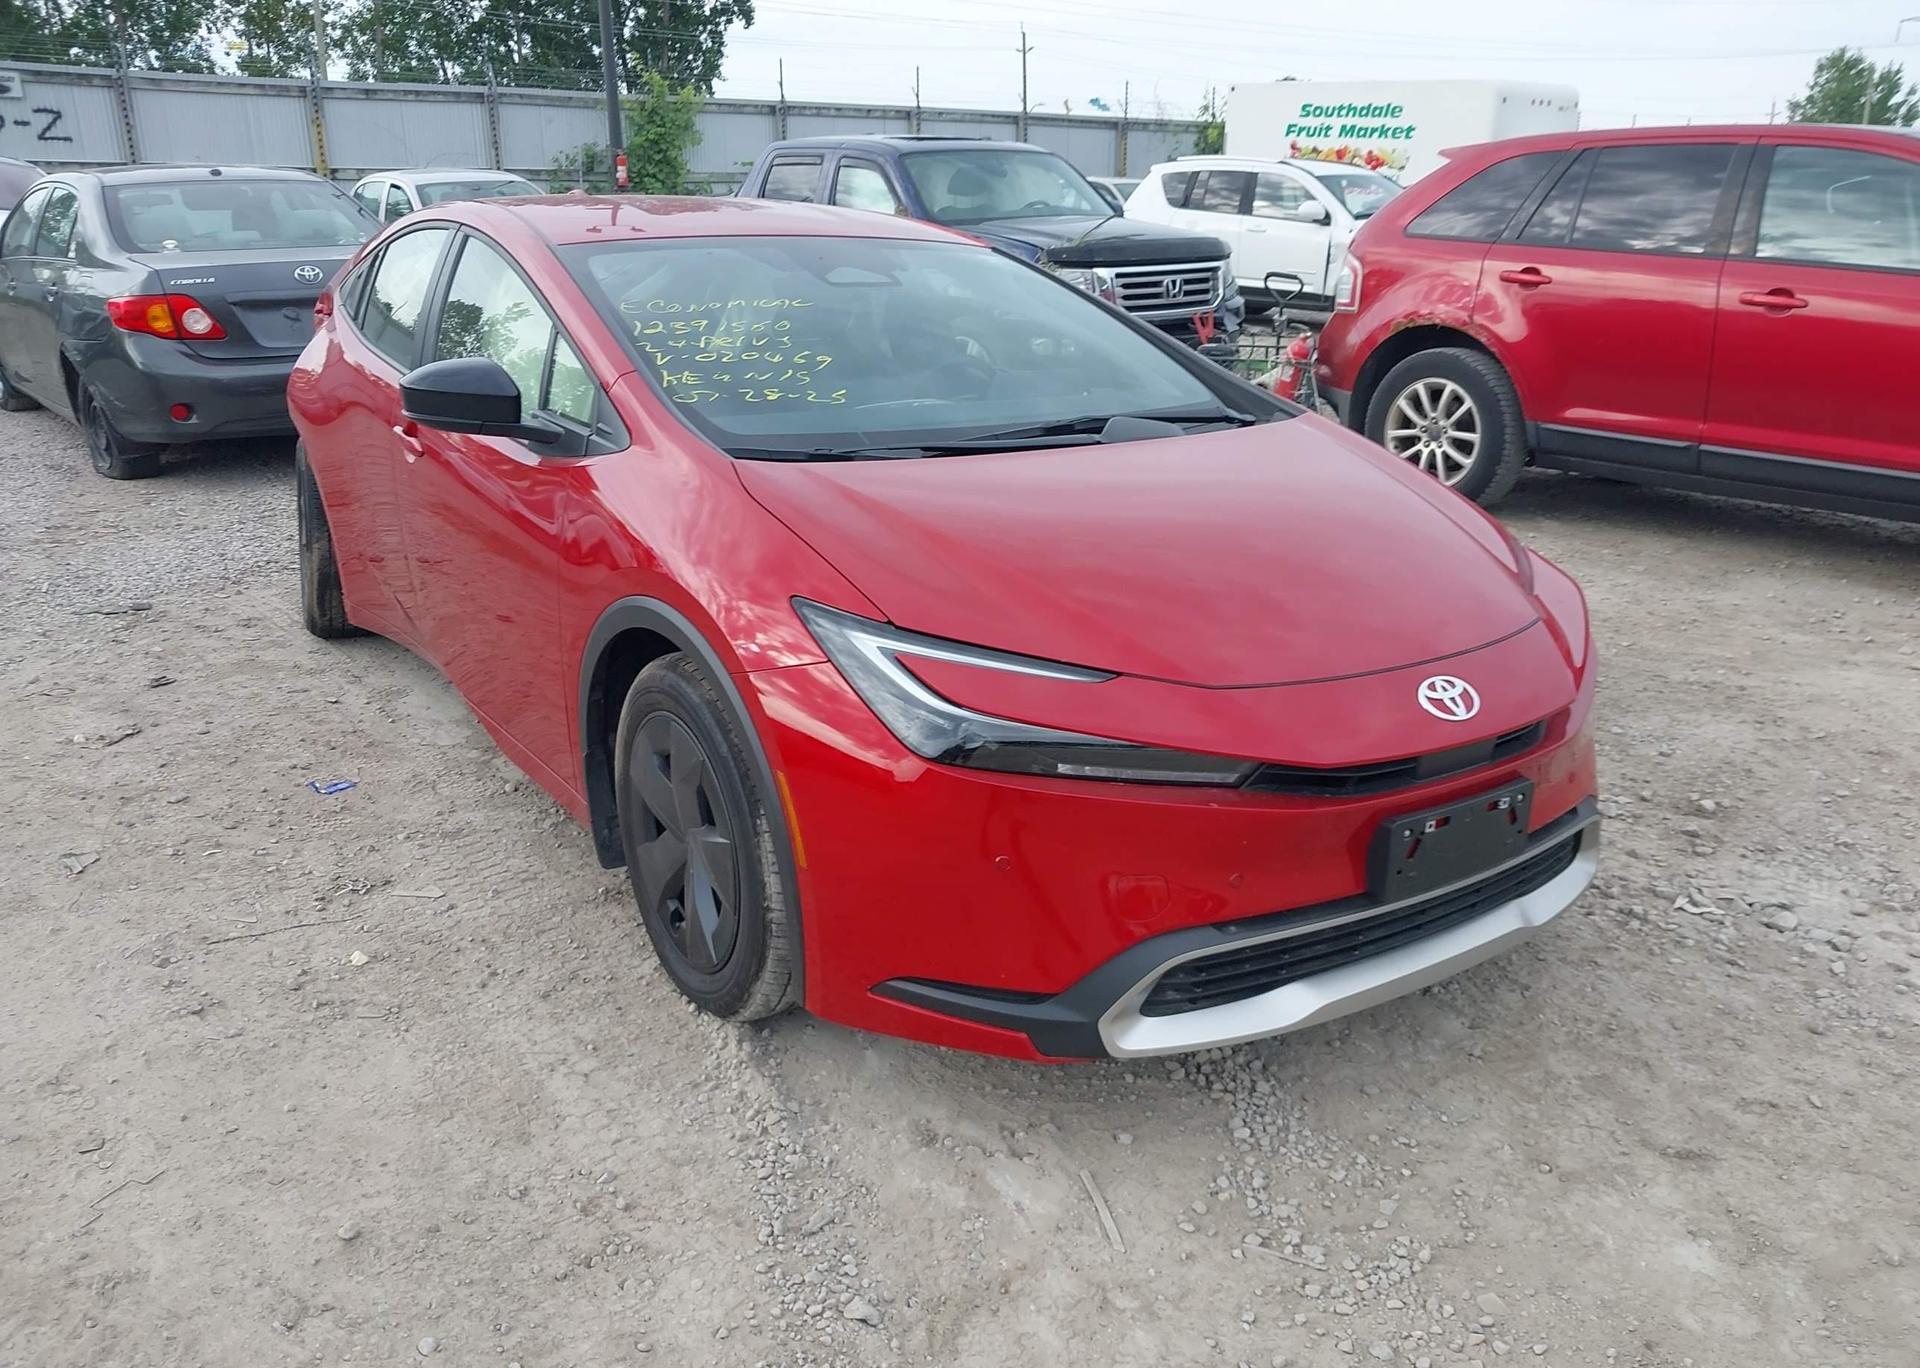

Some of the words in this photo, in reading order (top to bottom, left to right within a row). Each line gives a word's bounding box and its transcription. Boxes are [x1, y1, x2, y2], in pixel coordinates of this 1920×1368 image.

[1299, 102, 1404, 120] Southdale
[1284, 122, 1334, 138] Fruit
[1338, 123, 1416, 140] Market
